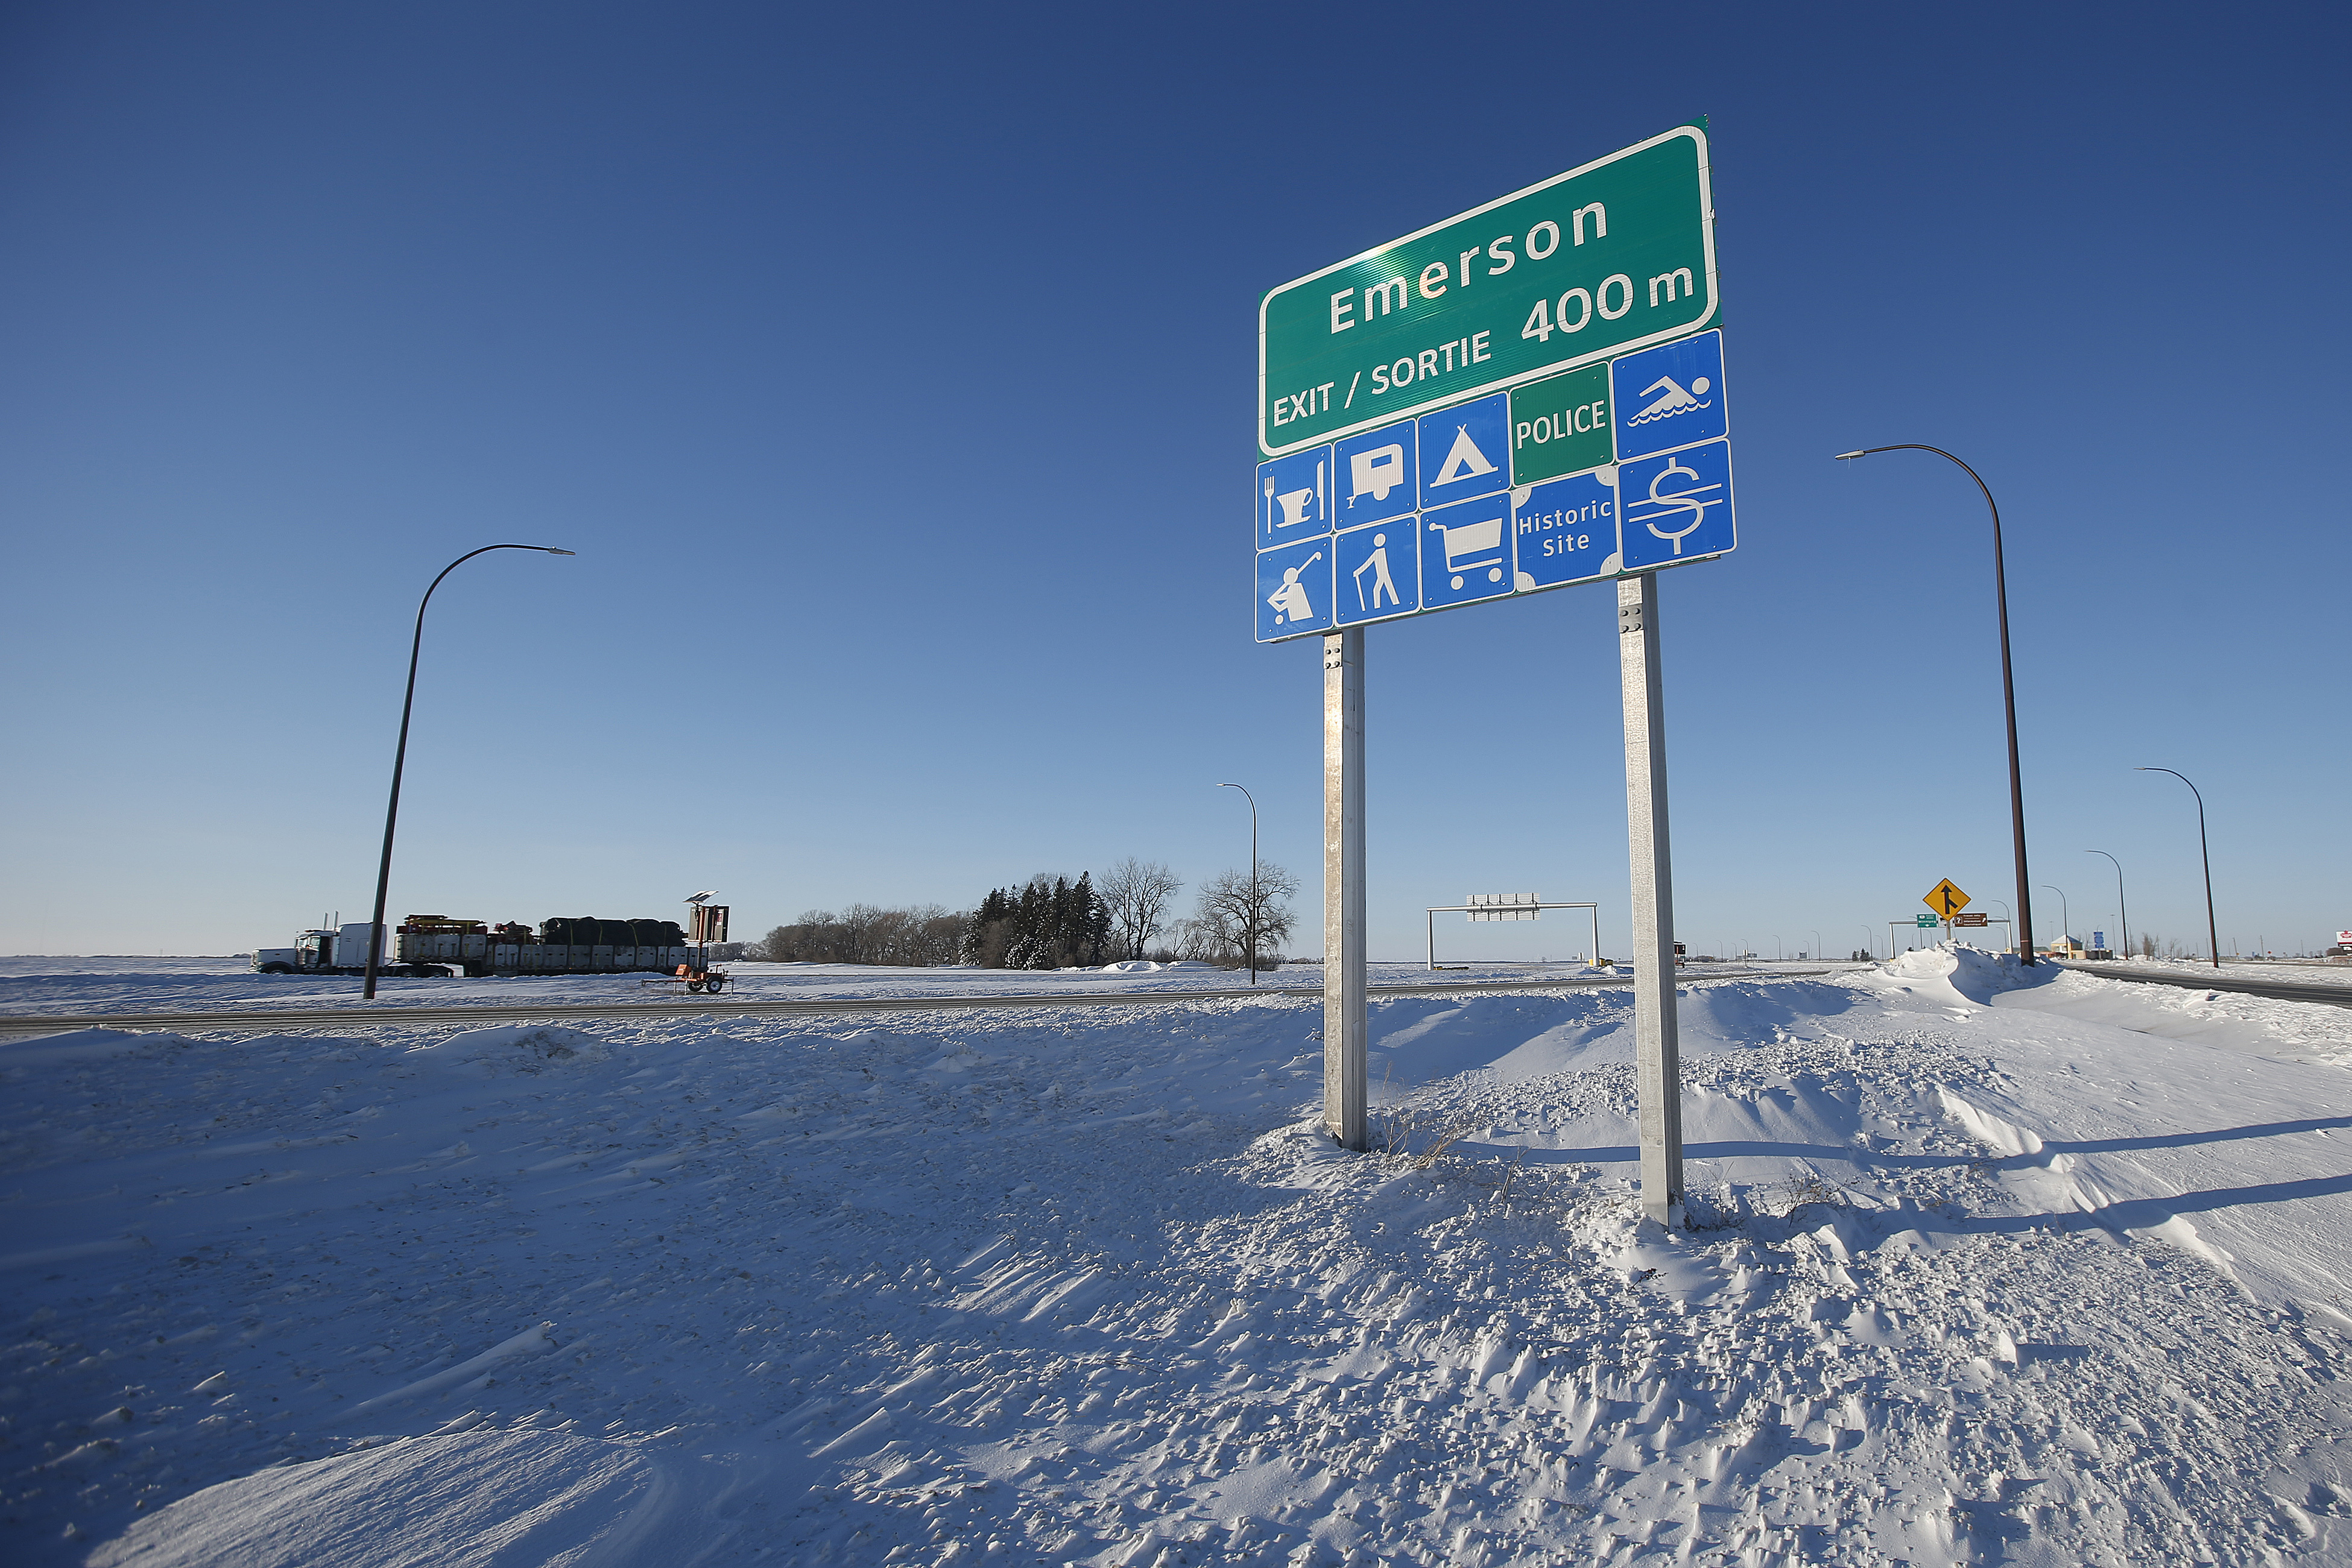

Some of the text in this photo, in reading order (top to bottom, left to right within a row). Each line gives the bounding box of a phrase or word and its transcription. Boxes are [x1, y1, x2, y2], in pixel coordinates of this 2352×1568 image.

[1330, 201, 1608, 335] Emerson
[1272, 267, 1694, 428] EXIT / SORTIE 400 m
[1516, 399, 1607, 450] POLICE
[1519, 499, 1612, 536] Historic
[1542, 532, 1590, 557] Site
